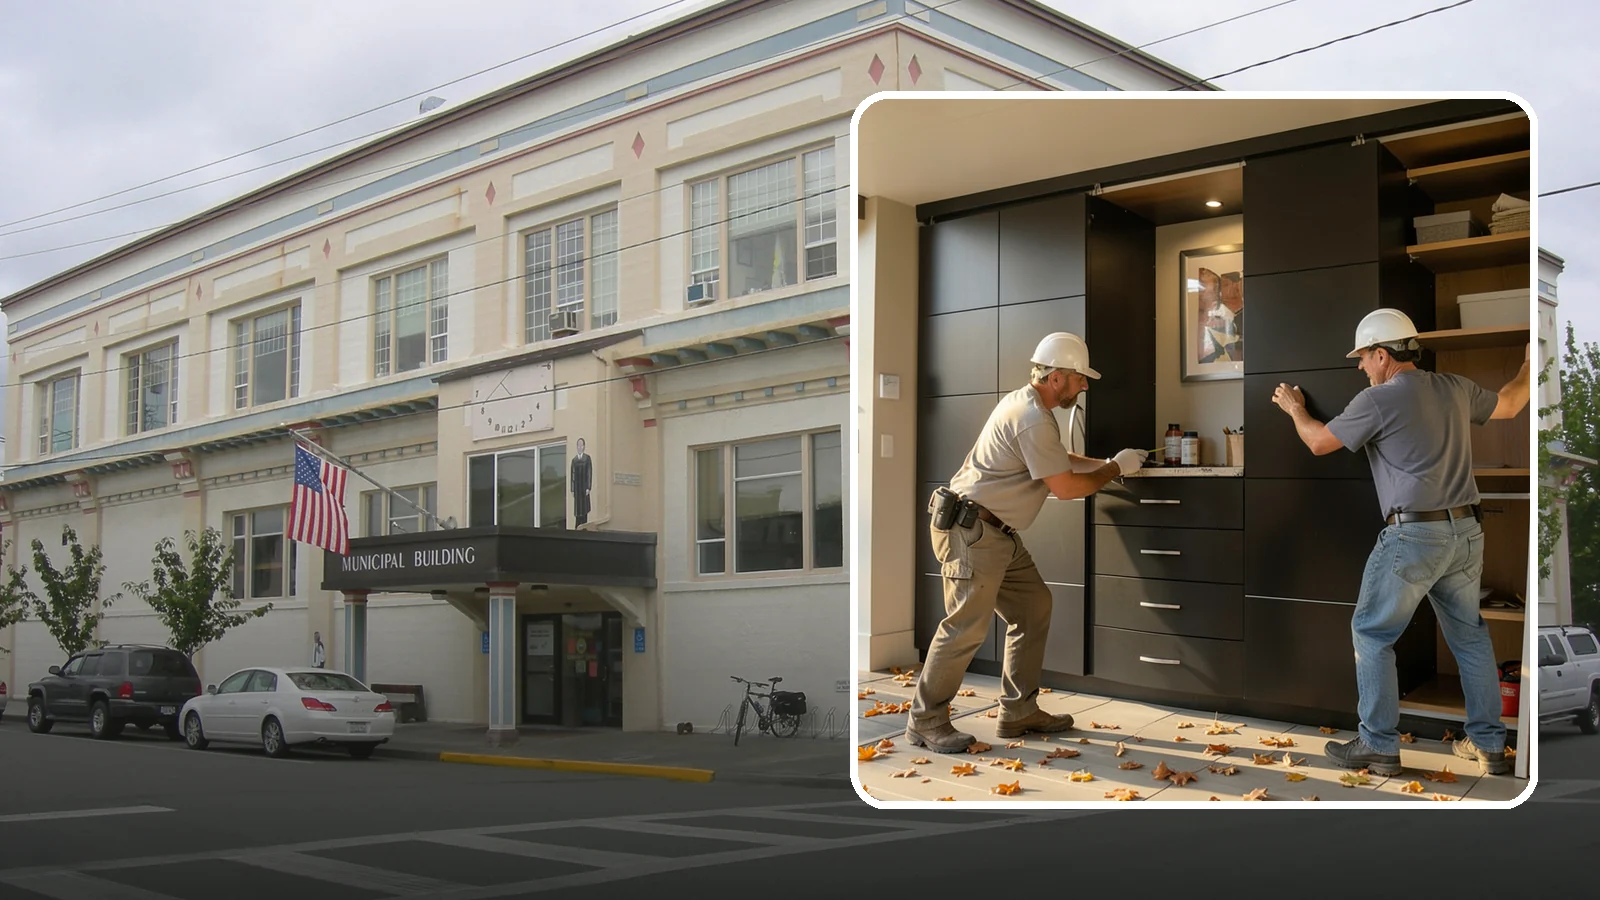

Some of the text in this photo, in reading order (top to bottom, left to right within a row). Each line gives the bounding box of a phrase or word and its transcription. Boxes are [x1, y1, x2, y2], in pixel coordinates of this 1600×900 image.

[475, 390, 479, 398] 7
[481, 407, 485, 415] 8
[488, 417, 492, 425] 9
[494, 423, 500, 431] 10
[501, 425, 506, 433] 11
[507, 425, 514, 433] 12
[521, 420, 525, 428] 2
[529, 413, 533, 422] 3
[536, 402, 540, 410] 4
[342, 546, 475, 572] MUNICIPAL BUILDING
